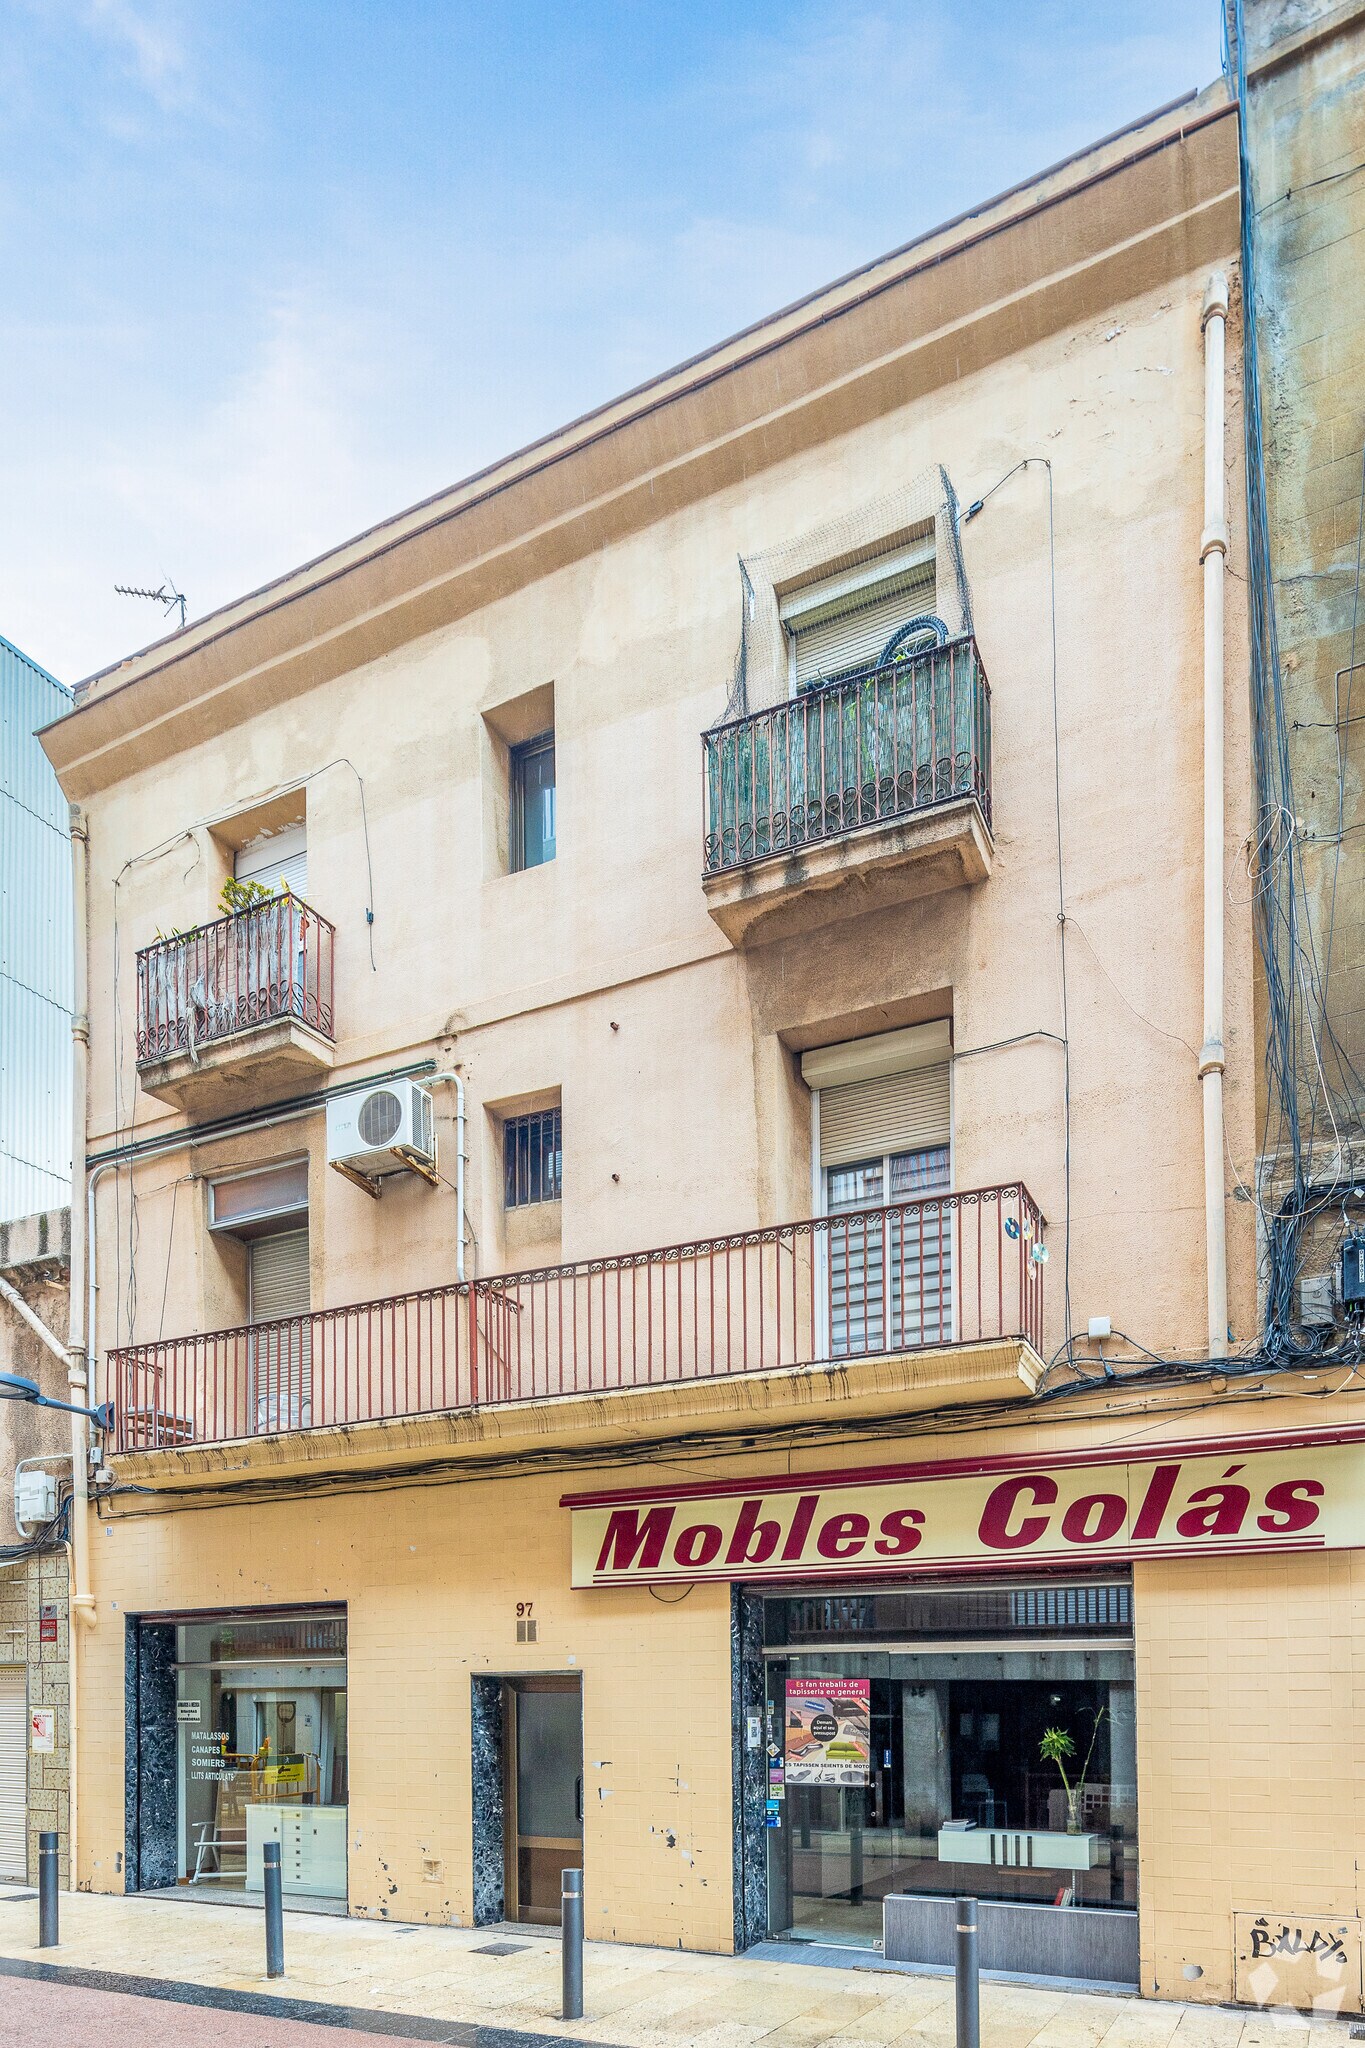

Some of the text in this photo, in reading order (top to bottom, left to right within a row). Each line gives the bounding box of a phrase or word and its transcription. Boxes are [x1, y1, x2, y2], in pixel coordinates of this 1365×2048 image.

[595, 1464, 1325, 1570] Mobles Colás
[516, 1602, 533, 1617] 97
[837, 1688, 866, 1696] general
[191, 1731, 230, 1741] MATALASSOS
[191, 1745, 220, 1754] CANAPES
[191, 1758, 226, 1768] SOMIERS
[191, 1771, 235, 1782] LLITS ARTICULATS
